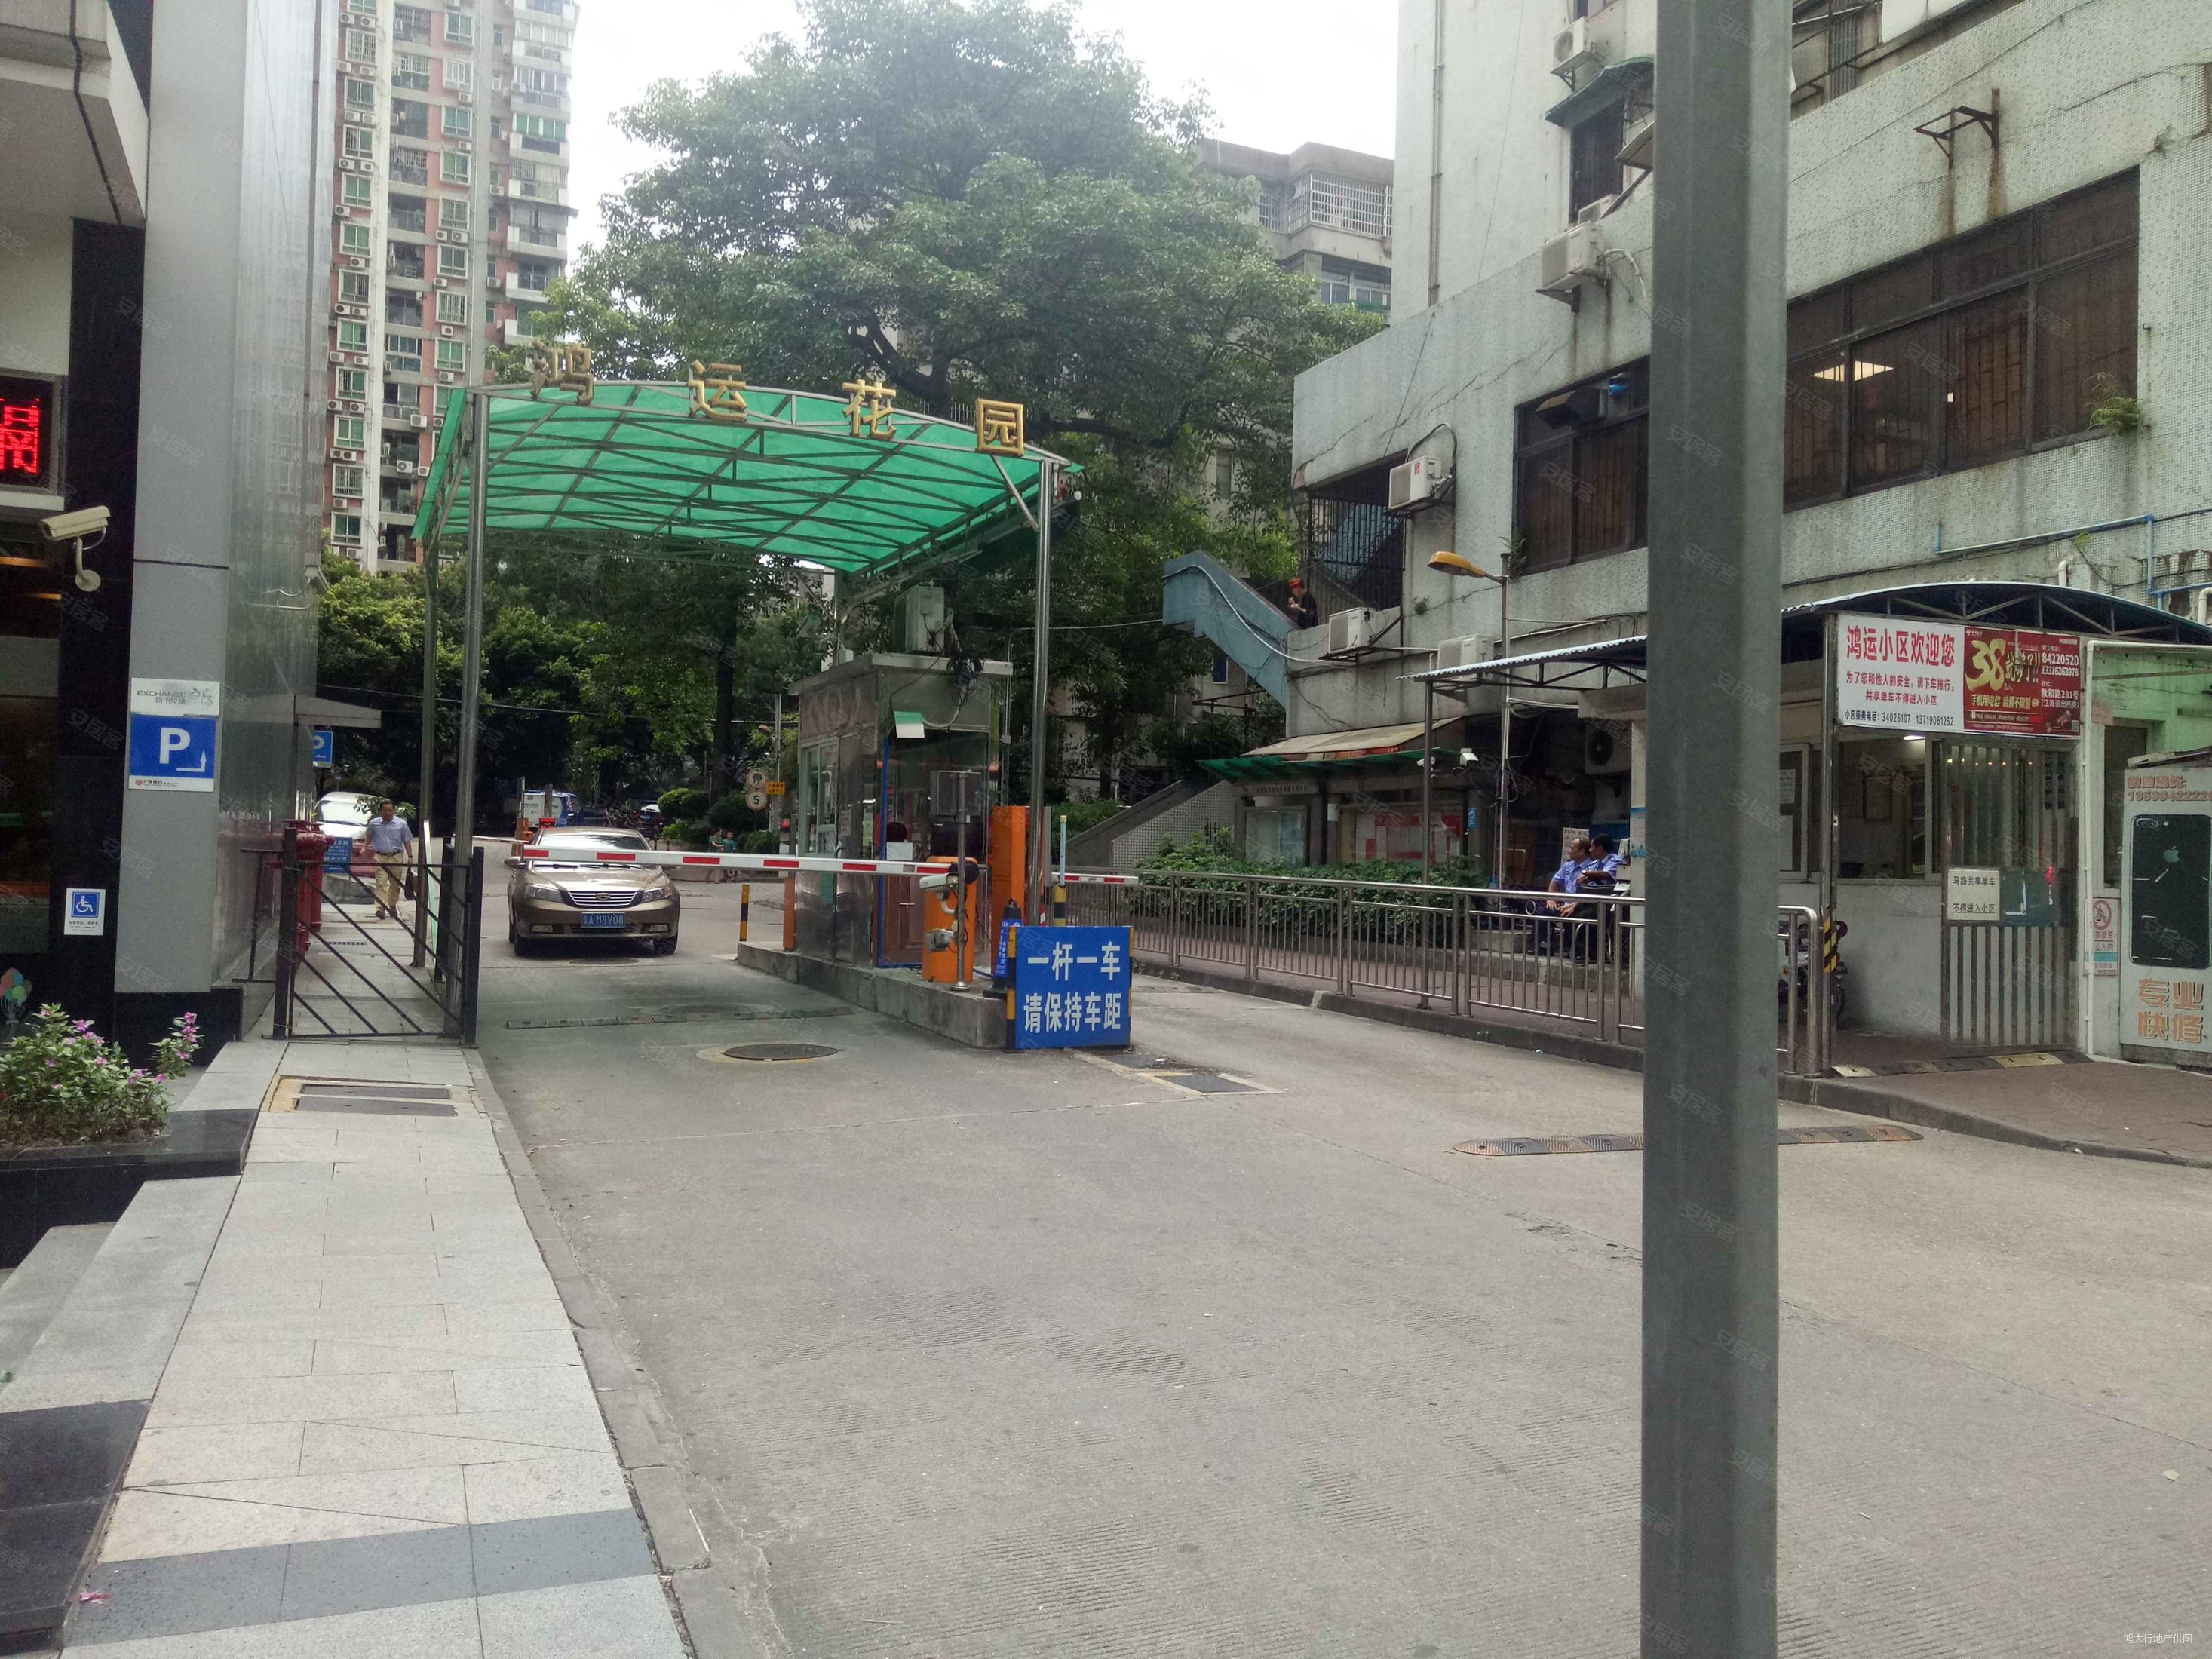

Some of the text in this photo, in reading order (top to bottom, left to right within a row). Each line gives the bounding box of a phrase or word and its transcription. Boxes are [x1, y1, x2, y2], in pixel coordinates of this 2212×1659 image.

[530, 341, 1025, 457] 鸿运花园
[1846, 625, 1955, 668] 鸿运小区欢迎您
[2042, 653, 2079, 666] 84220520
[1865, 689, 1937, 706] 共享单车不得进入小区
[1916, 714, 1954, 726] 13719061252
[159, 726, 191, 765] P
[753, 795, 760, 805] 5
[1952, 875, 1996, 886] 马路共享单车
[1952, 903, 1996, 914] 不得进入小区
[1026, 941, 1121, 983] 一杆一车
[2138, 978, 2204, 1010] 专业
[1023, 991, 1122, 1034] 请保持车距
[2137, 1010, 2203, 1044] 快修
